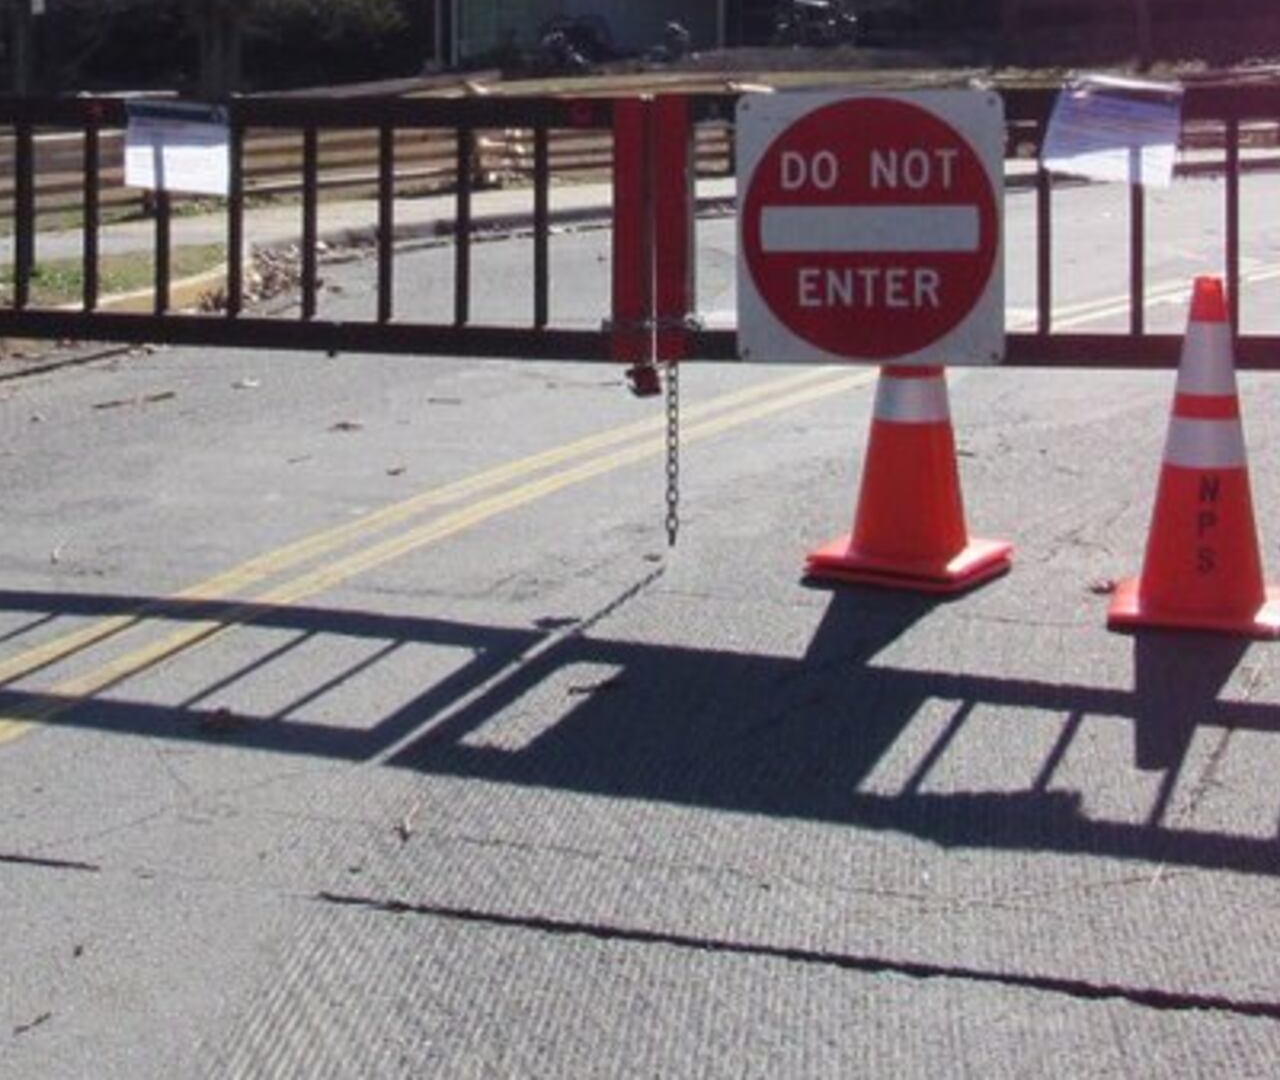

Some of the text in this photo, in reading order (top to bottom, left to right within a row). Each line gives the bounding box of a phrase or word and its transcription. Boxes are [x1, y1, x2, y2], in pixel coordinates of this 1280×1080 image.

[780, 148, 959, 190] DO NOT
[798, 268, 941, 308] ENTER
[1197, 474, 1220, 573] NPS
